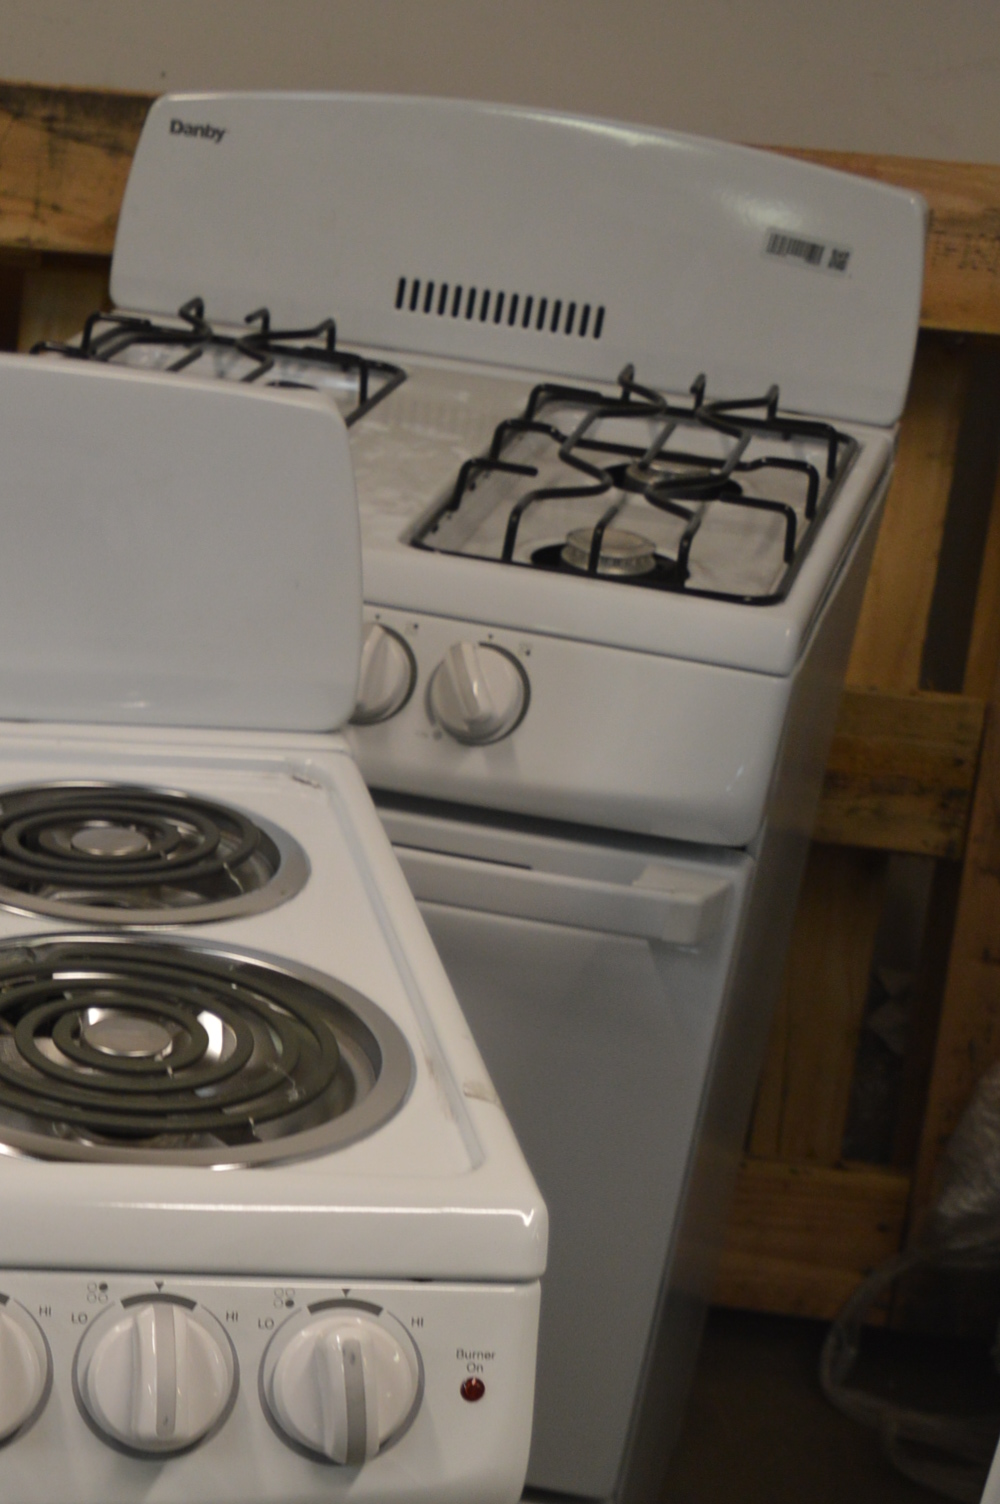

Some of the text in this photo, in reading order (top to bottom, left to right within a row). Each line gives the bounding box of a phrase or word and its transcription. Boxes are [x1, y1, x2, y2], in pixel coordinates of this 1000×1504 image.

[169, 118, 226, 144] Danby
[38, 1305, 52, 1317] HI
[225, 1310, 239, 1323] HI
[71, 1312, 88, 1325] LO
[257, 1318, 275, 1330] LO
[411, 1317, 424, 1328] HI
[456, 1349, 496, 1362] Burner
[466, 1361, 484, 1374] On
